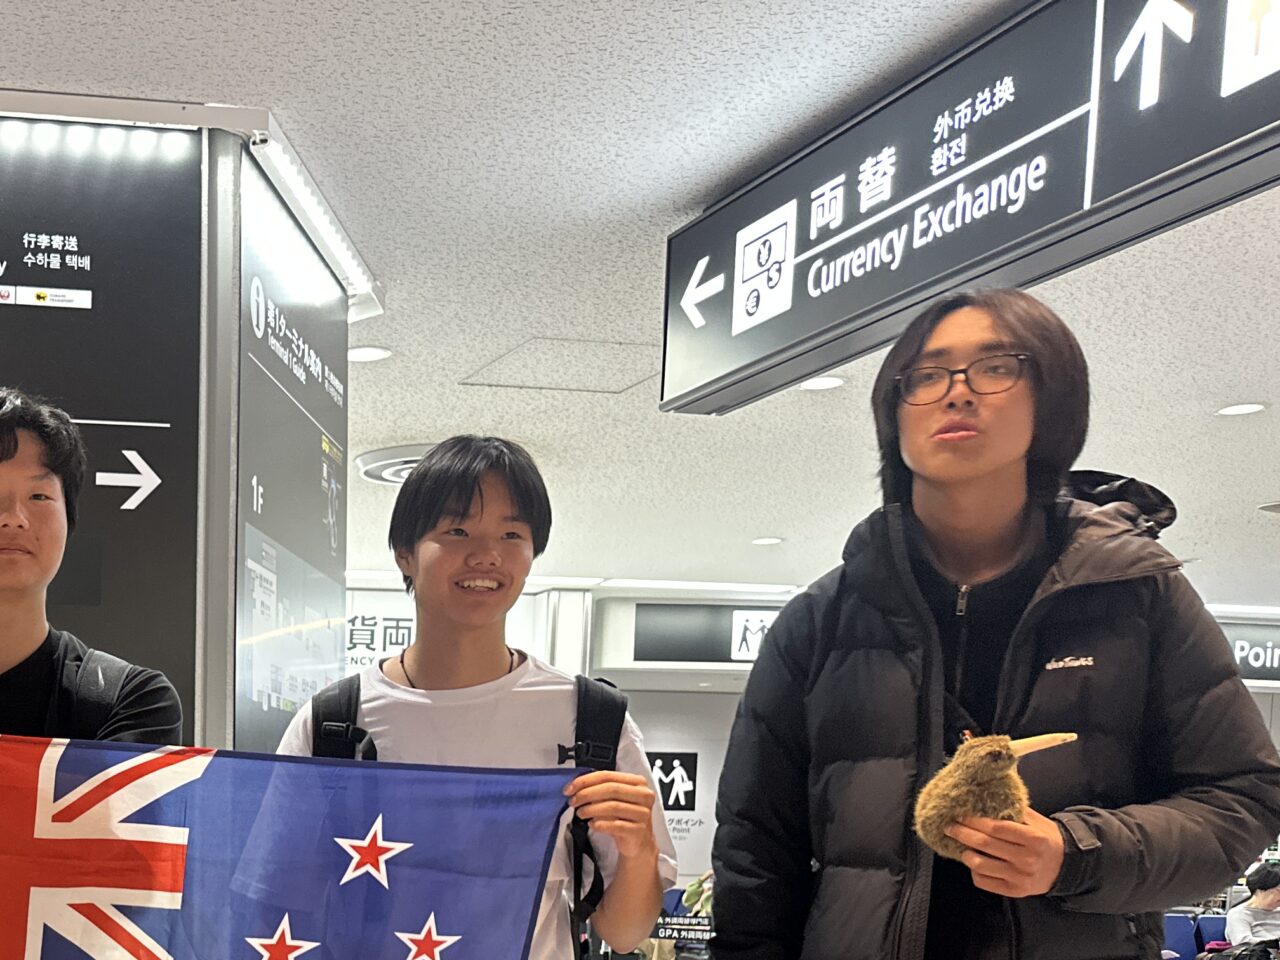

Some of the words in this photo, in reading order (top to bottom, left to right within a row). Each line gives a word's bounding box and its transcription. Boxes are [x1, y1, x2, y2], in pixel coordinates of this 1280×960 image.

[933, 76, 1015, 143] 外币兑换
[930, 132, 966, 176] 환전
[810, 146, 896, 240] 両替
[23, 232, 78, 251] 行李寄送
[807, 224, 908, 297] Currency
[912, 155, 1047, 249] Exchange
[23, 252, 61, 269] 수하물
[65, 254, 91, 271] 택배
[251, 475, 264, 514] 1F
[658, 928, 679, 938] GPA
